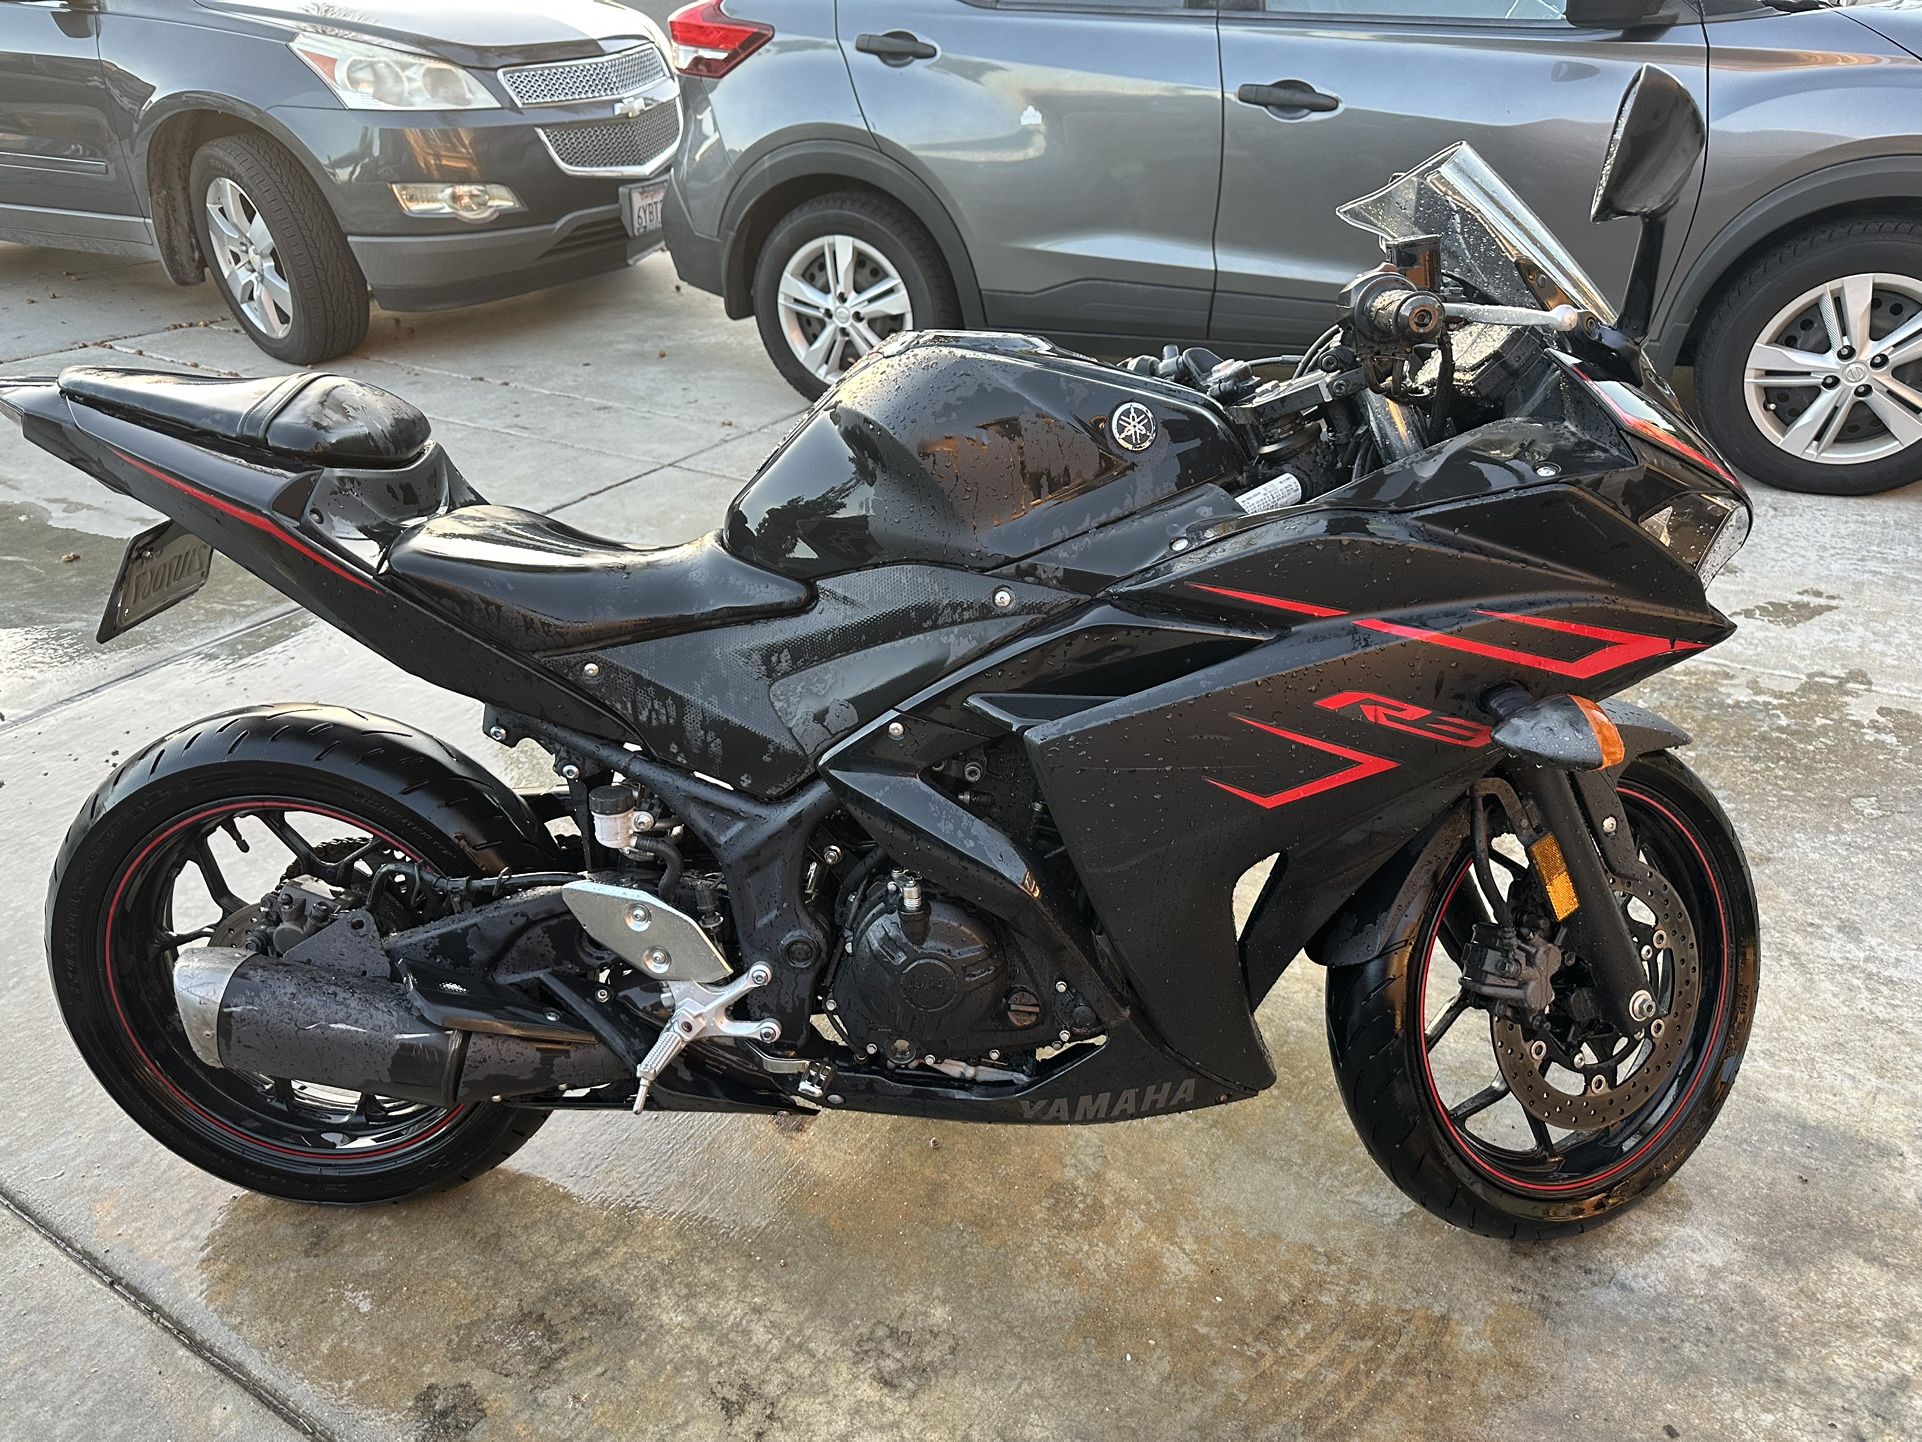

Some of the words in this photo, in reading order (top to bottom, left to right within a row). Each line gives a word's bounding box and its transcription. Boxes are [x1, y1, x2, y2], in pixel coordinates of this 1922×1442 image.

[637, 200, 663, 226] 6YBT
[1313, 690, 1492, 749] R3
[1019, 1077, 1196, 1122] YAMAHA
